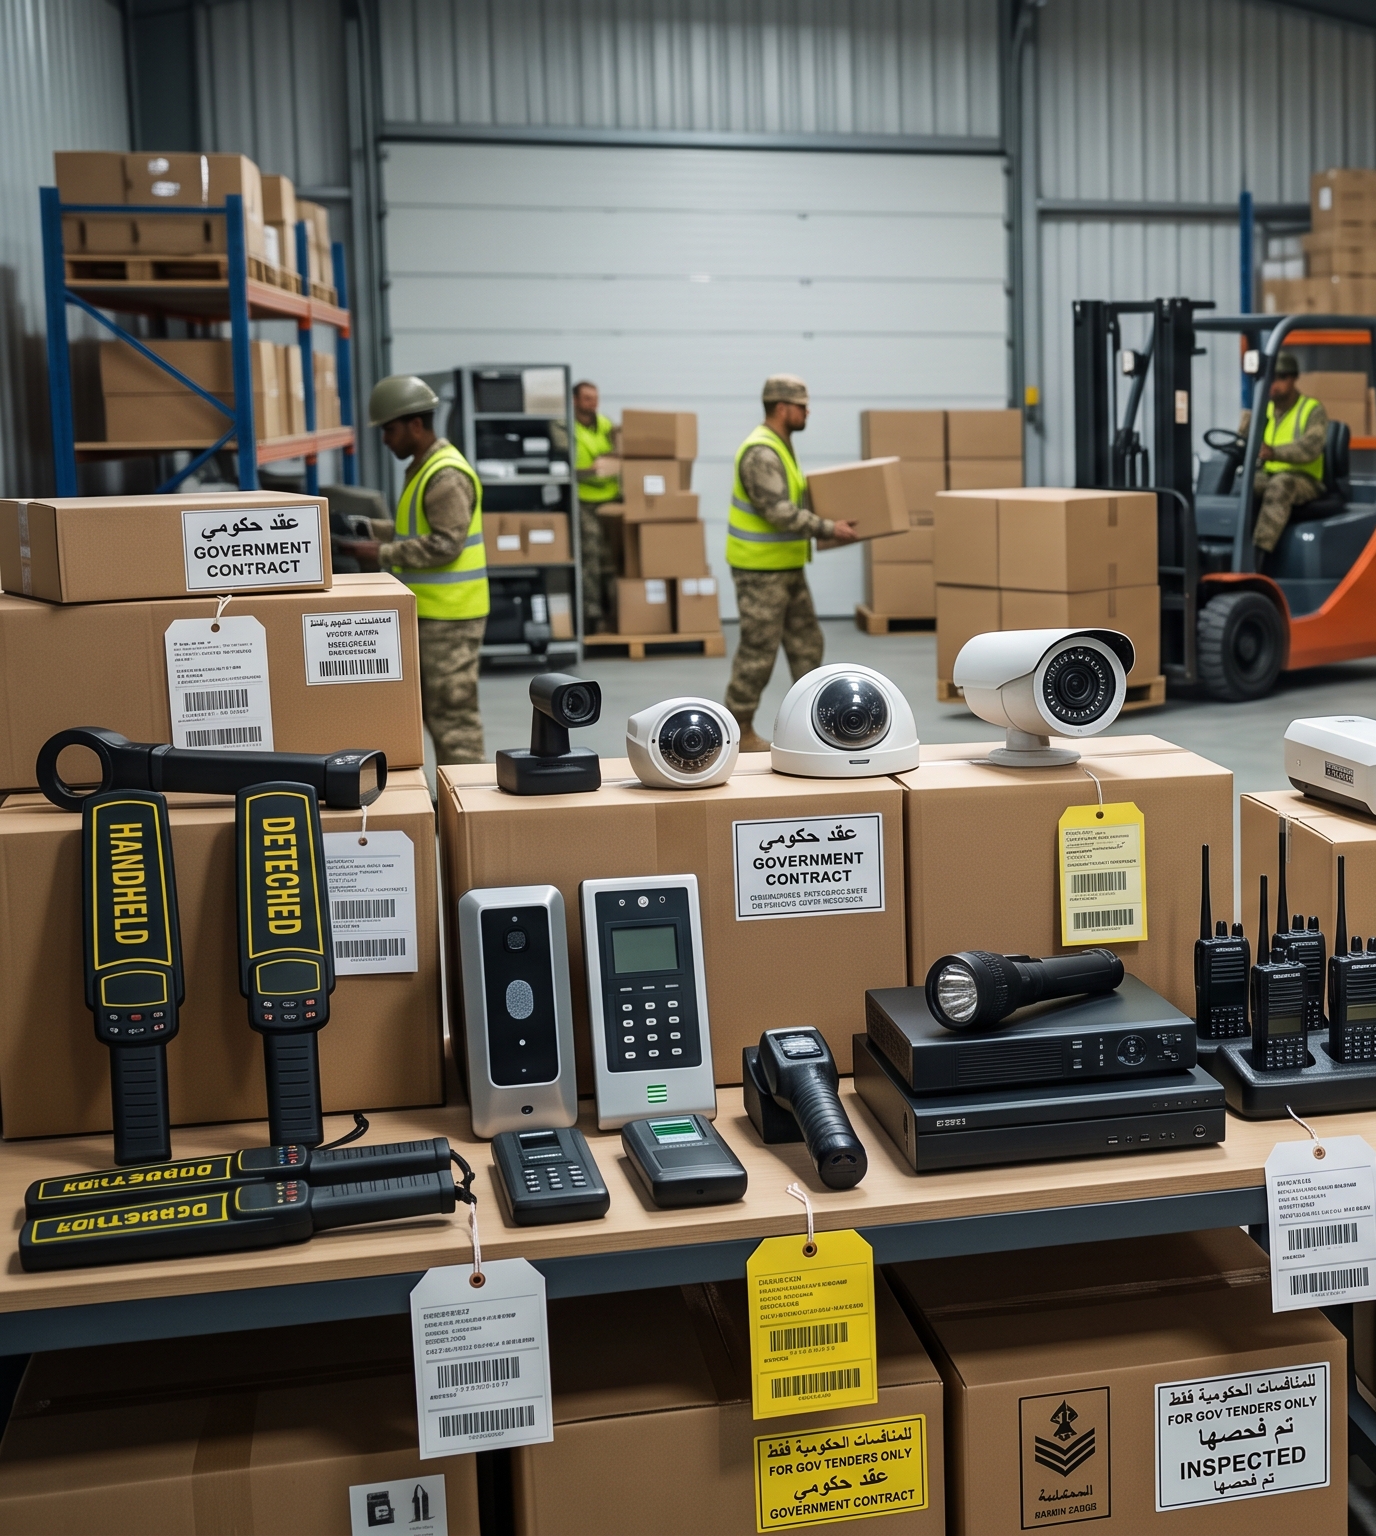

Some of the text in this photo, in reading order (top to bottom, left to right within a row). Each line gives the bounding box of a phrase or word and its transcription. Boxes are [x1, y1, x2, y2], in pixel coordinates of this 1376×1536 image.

[202, 513, 298, 541] عقد حكومي
[194, 541, 311, 560] GOVERNMENT
[207, 560, 300, 577] CONTRACT
[759, 824, 857, 853] عقد حكومي
[262, 816, 302, 935] DETECHED
[753, 852, 864, 870] GOVERNMENT
[109, 822, 149, 944] HANDHELD
[766, 870, 852, 886] CONTRACT
[1168, 1374, 1316, 1406] للمنافسات الحكومية فقط
[1168, 1396, 1318, 1426] FOR GOV TENDERS ONLY
[768, 1427, 912, 1458] للمنافسات الحكومية فقط
[1199, 1417, 1294, 1451] تم فحصها
[770, 1448, 912, 1476] FOR GOV TENDERS ONLY
[1180, 1446, 1306, 1480] INSPECTED
[794, 1468, 888, 1503] عقد حكومي
[1214, 1473, 1274, 1494] تم فحصها
[770, 1490, 915, 1520] GOVERNMENT CONTRACT
